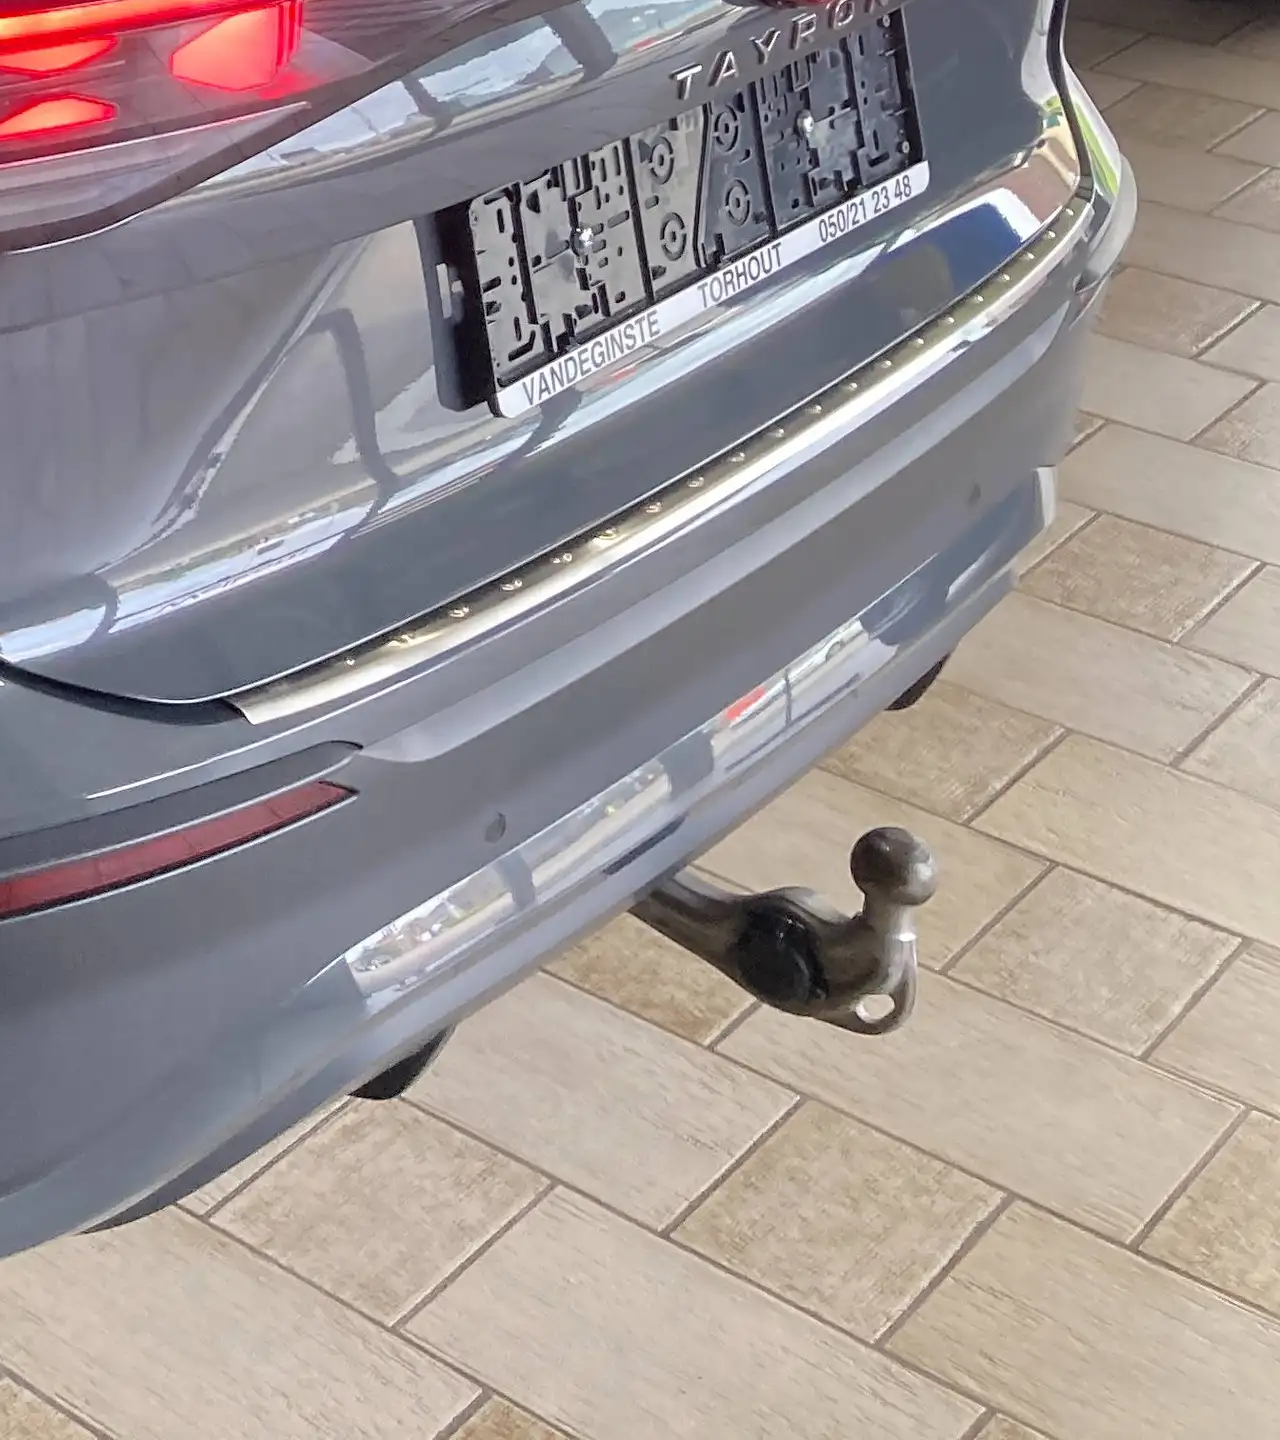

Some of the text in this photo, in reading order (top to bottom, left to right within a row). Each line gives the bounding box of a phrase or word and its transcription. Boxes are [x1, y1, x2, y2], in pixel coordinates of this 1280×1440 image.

[522, 174, 913, 406] VANDEGINSTE TORHOUT 050/21 23 48
